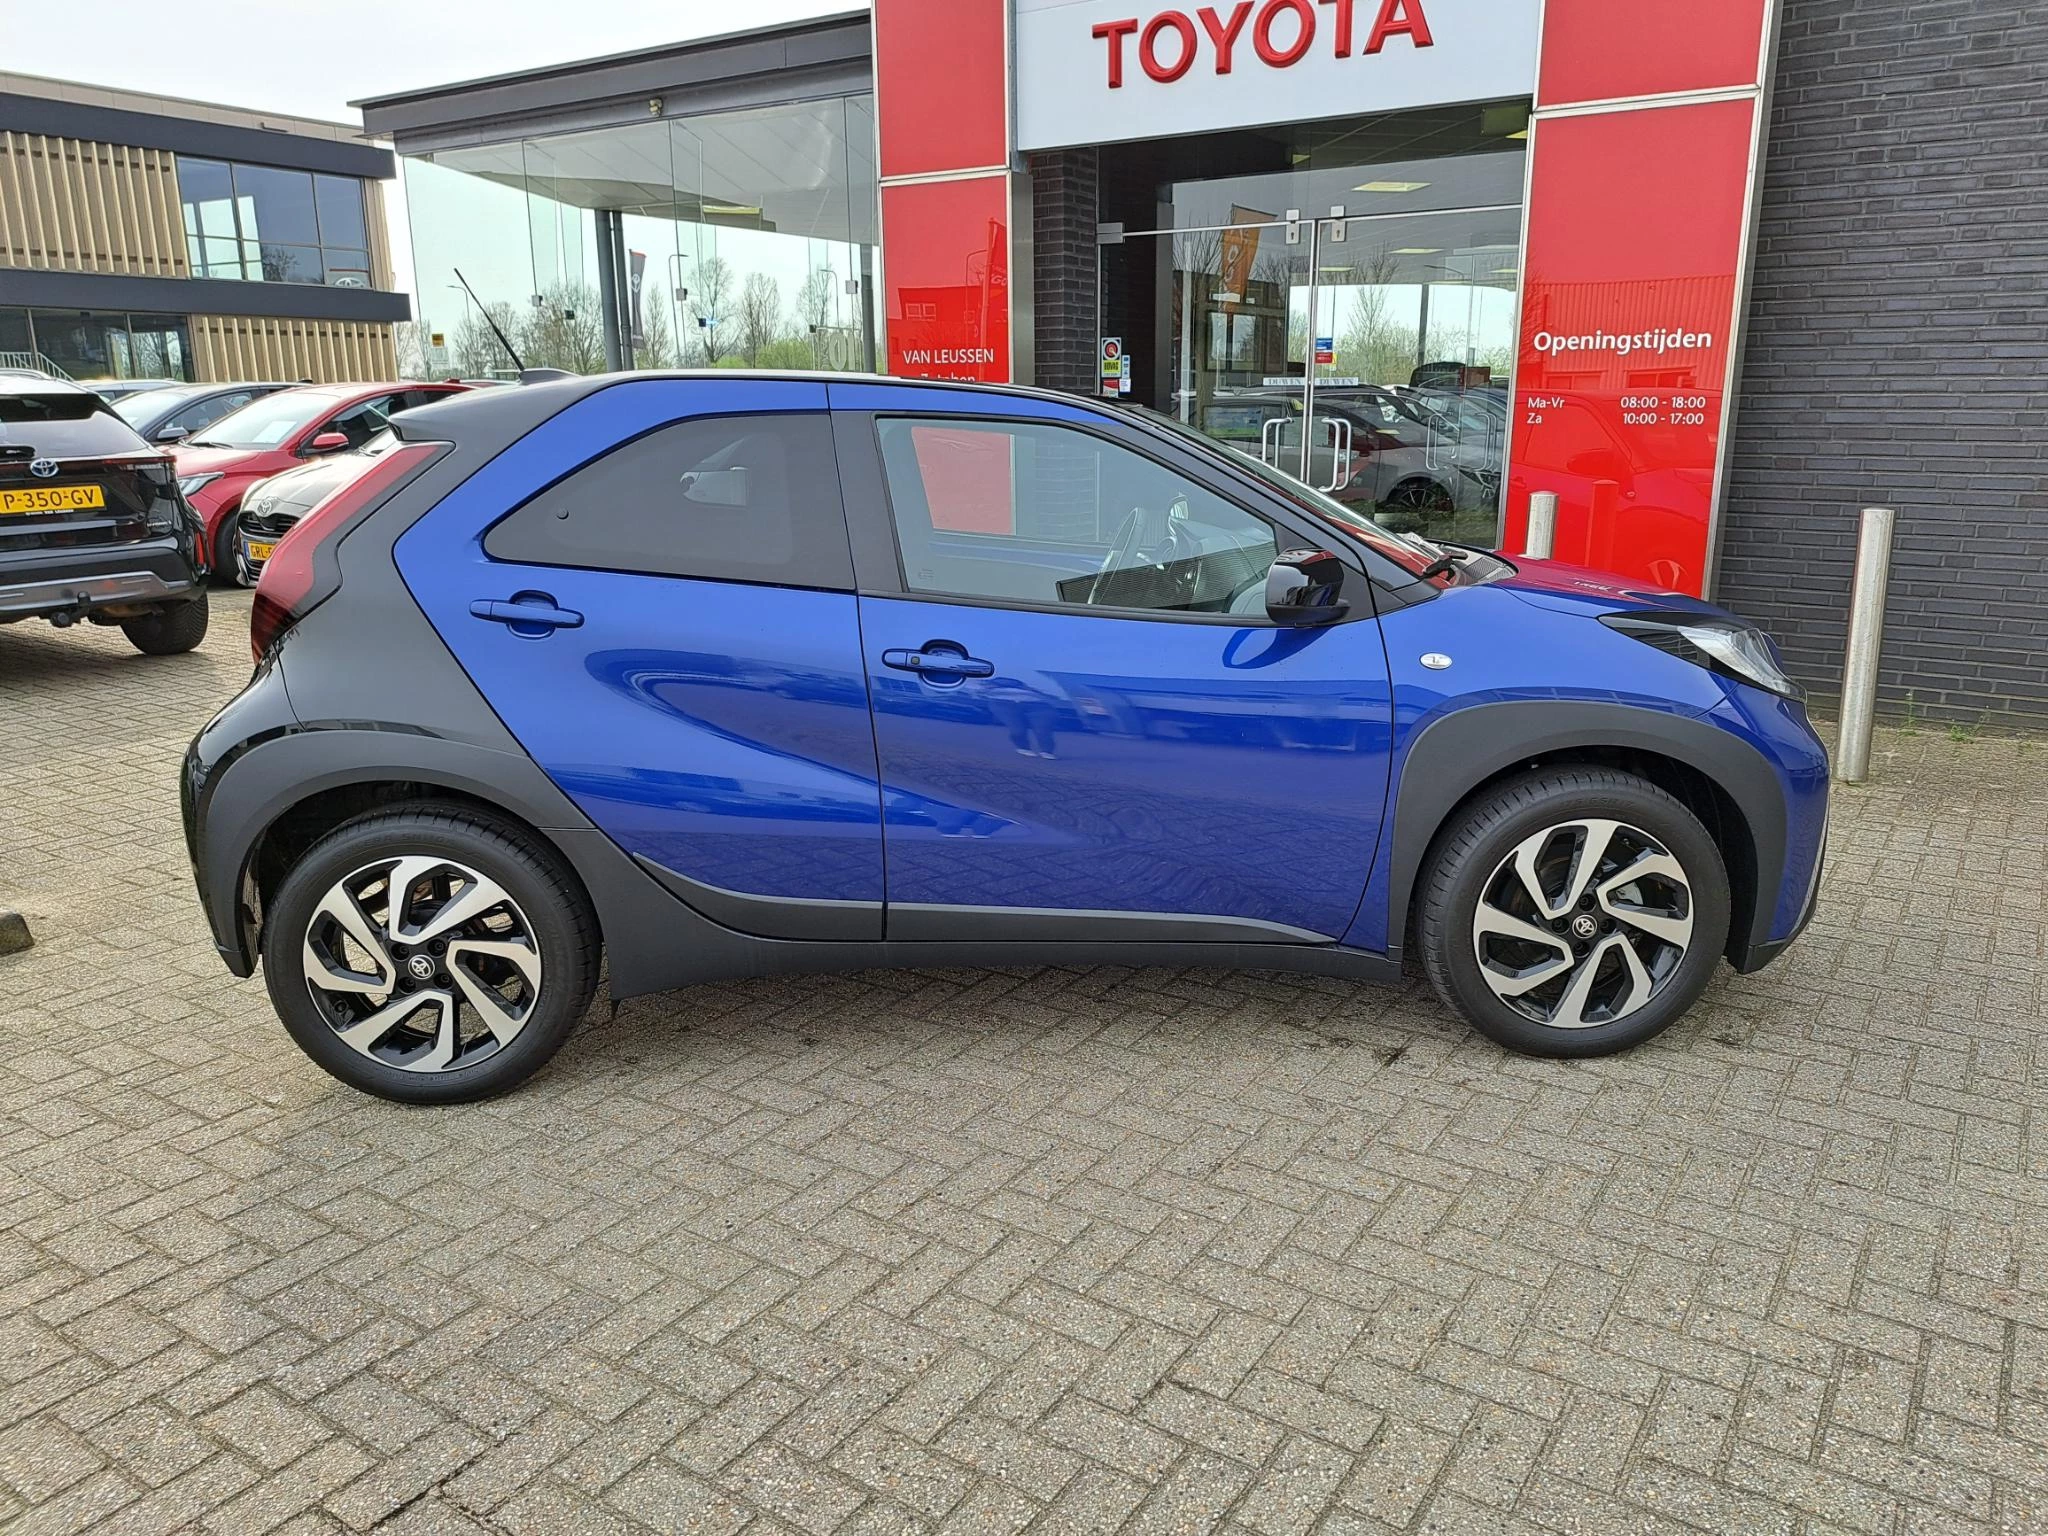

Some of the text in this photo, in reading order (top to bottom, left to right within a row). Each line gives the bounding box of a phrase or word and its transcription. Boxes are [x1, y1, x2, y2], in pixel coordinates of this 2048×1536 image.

[1092, 0, 1434, 89] TOYOTA
[1534, 328, 1712, 355] Openingstijden
[903, 348, 994, 364] VAN LEUSSEN
[1527, 397, 1565, 408] Ma-Vr
[1620, 396, 1658, 409] 08:00
[1671, 396, 1706, 409] 18:00
[1526, 413, 1542, 424] Za
[1623, 412, 1656, 424] 10:00
[1670, 412, 1704, 424] 17:00
[3, 489, 94, 509] P-350-GV
